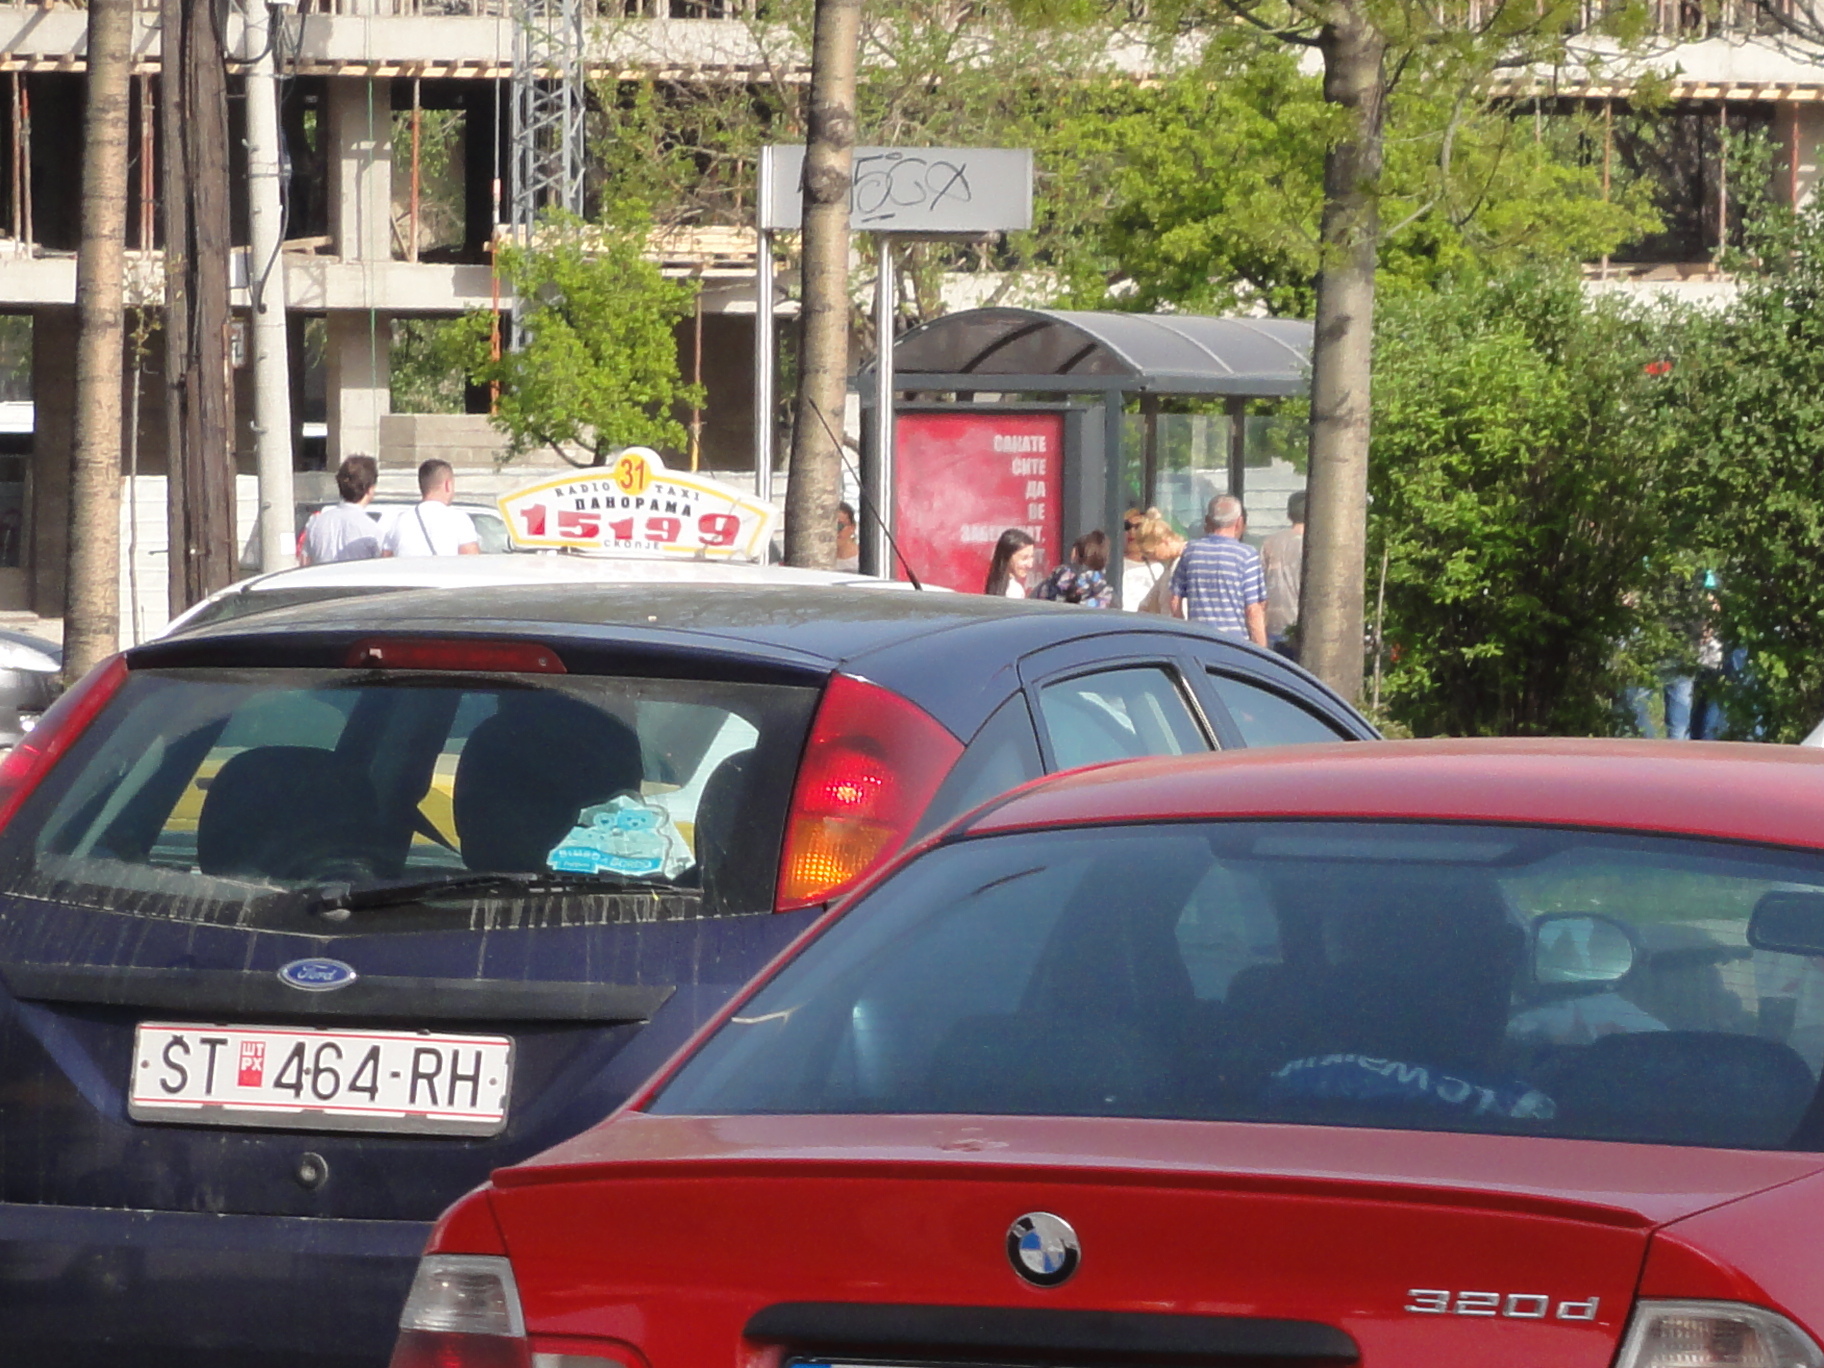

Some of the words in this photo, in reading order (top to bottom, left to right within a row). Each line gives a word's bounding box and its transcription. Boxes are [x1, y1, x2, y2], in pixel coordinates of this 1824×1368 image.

[619, 458, 646, 491] 31
[554, 481, 611, 498] RADIO
[655, 484, 700, 502] TAXI
[575, 497, 692, 518] ПАНОРАМА
[520, 503, 741, 547] 15199
[297, 964, 337, 981] Ford
[160, 1034, 229, 1096] ŠT
[272, 1040, 483, 1109] 464-RH
[1404, 1288, 1600, 1321] 320d
